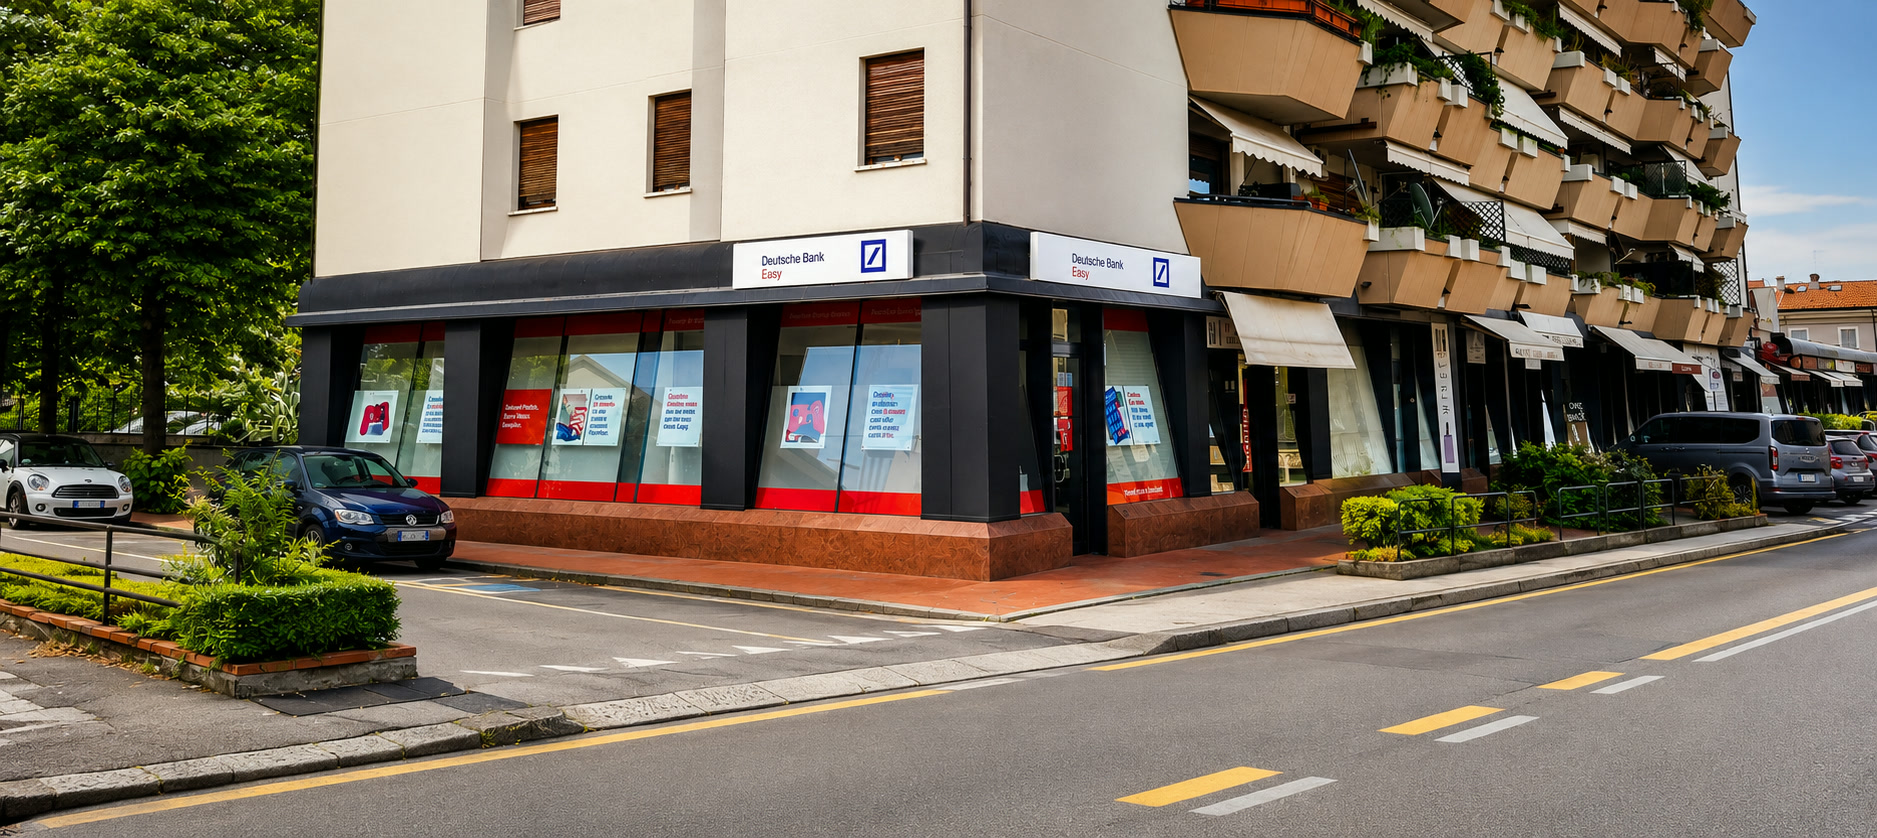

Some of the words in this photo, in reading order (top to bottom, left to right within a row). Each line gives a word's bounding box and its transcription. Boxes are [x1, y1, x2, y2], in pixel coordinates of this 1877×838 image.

[761, 254, 801, 267] Deutsche
[802, 251, 825, 263] Bank
[1071, 252, 1106, 268] Deutsche
[1106, 257, 1125, 270] Bank
[761, 268, 783, 281] Easy
[1071, 265, 1090, 281] Easy
